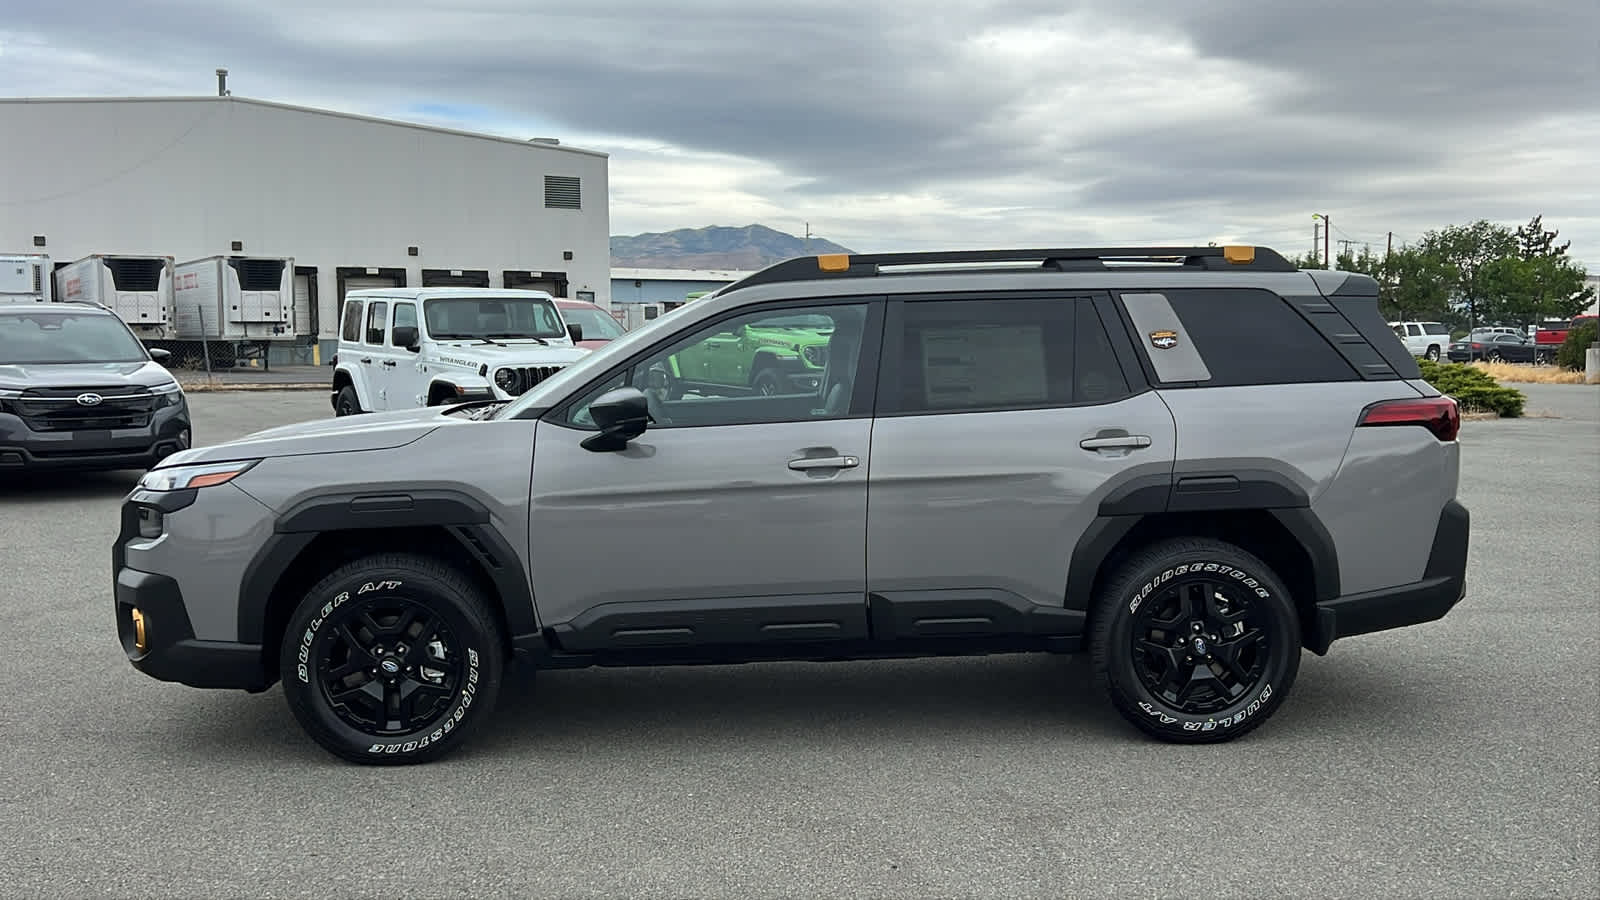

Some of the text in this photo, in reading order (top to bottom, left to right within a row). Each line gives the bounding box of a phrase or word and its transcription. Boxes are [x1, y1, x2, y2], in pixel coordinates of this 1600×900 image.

[1129, 562, 1270, 614] BRIDGESTONE
[298, 580, 402, 683] DUELER A/T
[368, 647, 479, 753] BRIDGESTONE
[1138, 684, 1273, 731] DUELER A/T
